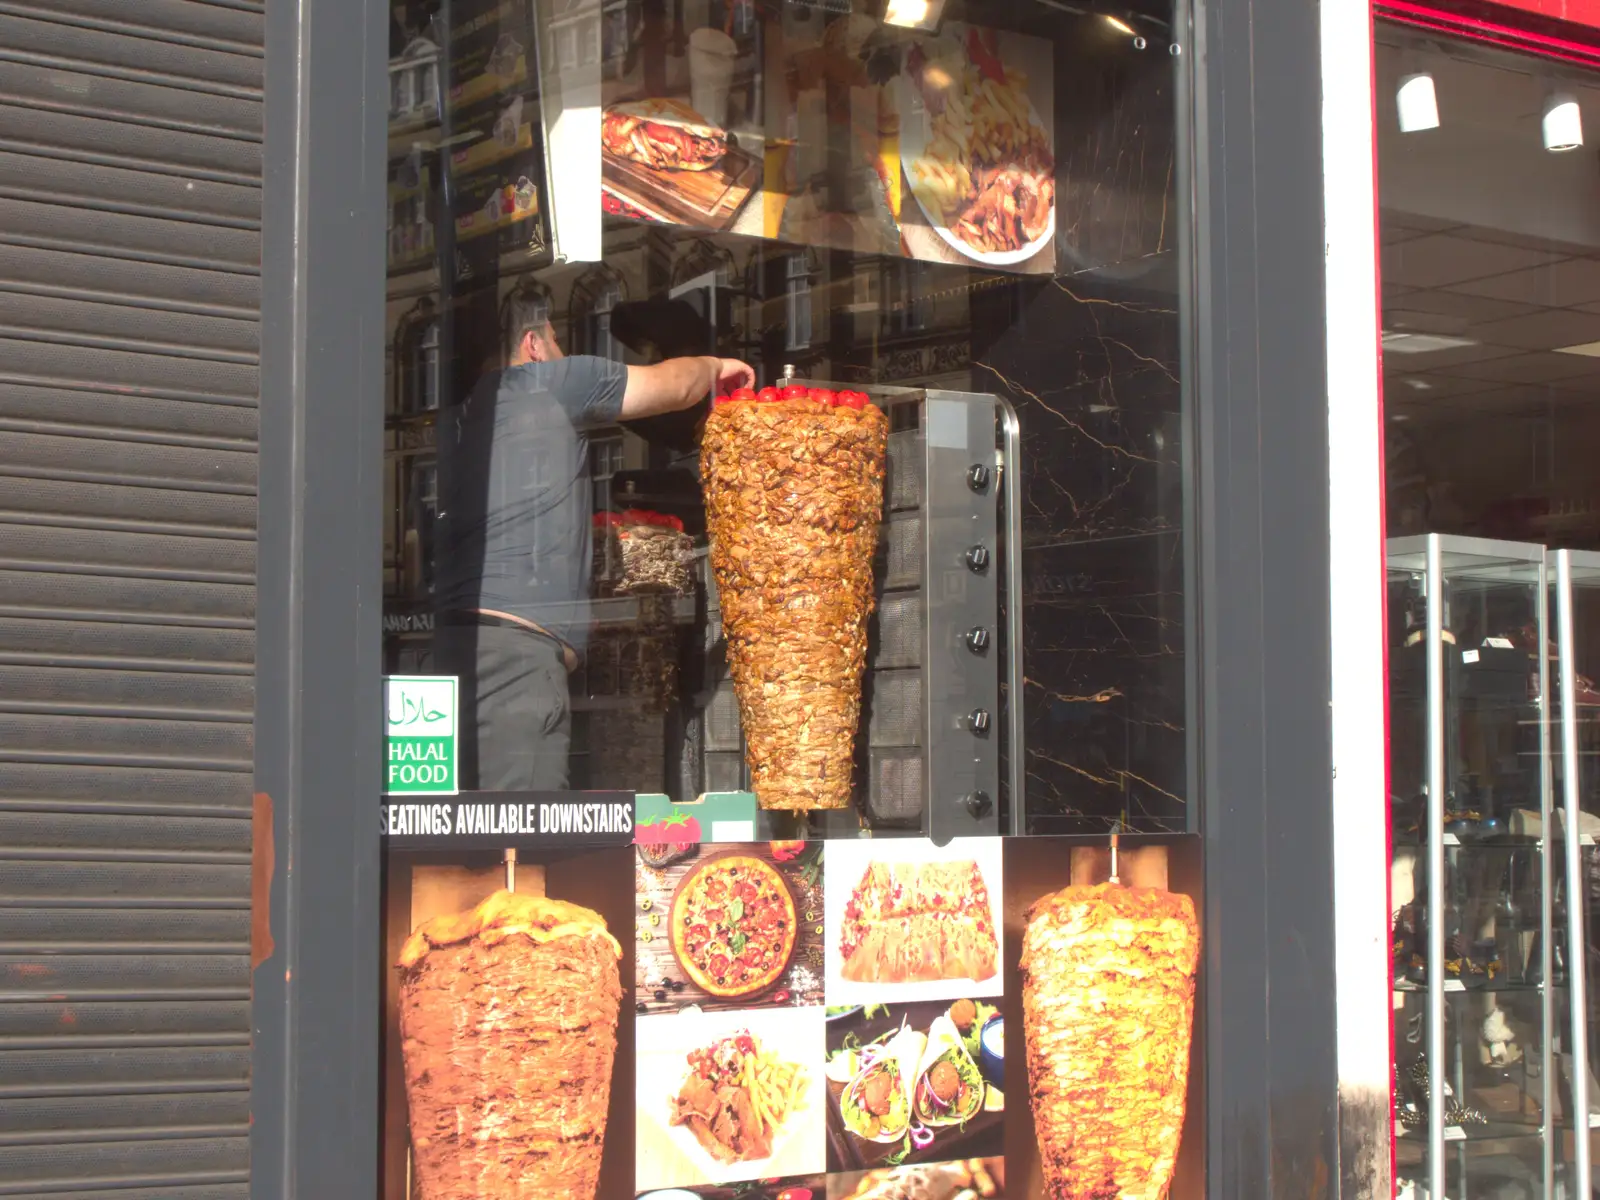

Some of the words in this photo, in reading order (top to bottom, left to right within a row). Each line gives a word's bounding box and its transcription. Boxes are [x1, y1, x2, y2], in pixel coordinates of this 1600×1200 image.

[388, 690, 447, 725] حلال
[388, 742, 448, 761] HALAL
[388, 764, 448, 784] FOOD
[380, 803, 452, 836] SEATINGS
[456, 803, 535, 835] AVAILABLE
[539, 803, 633, 834] DOWNSTAIRS
